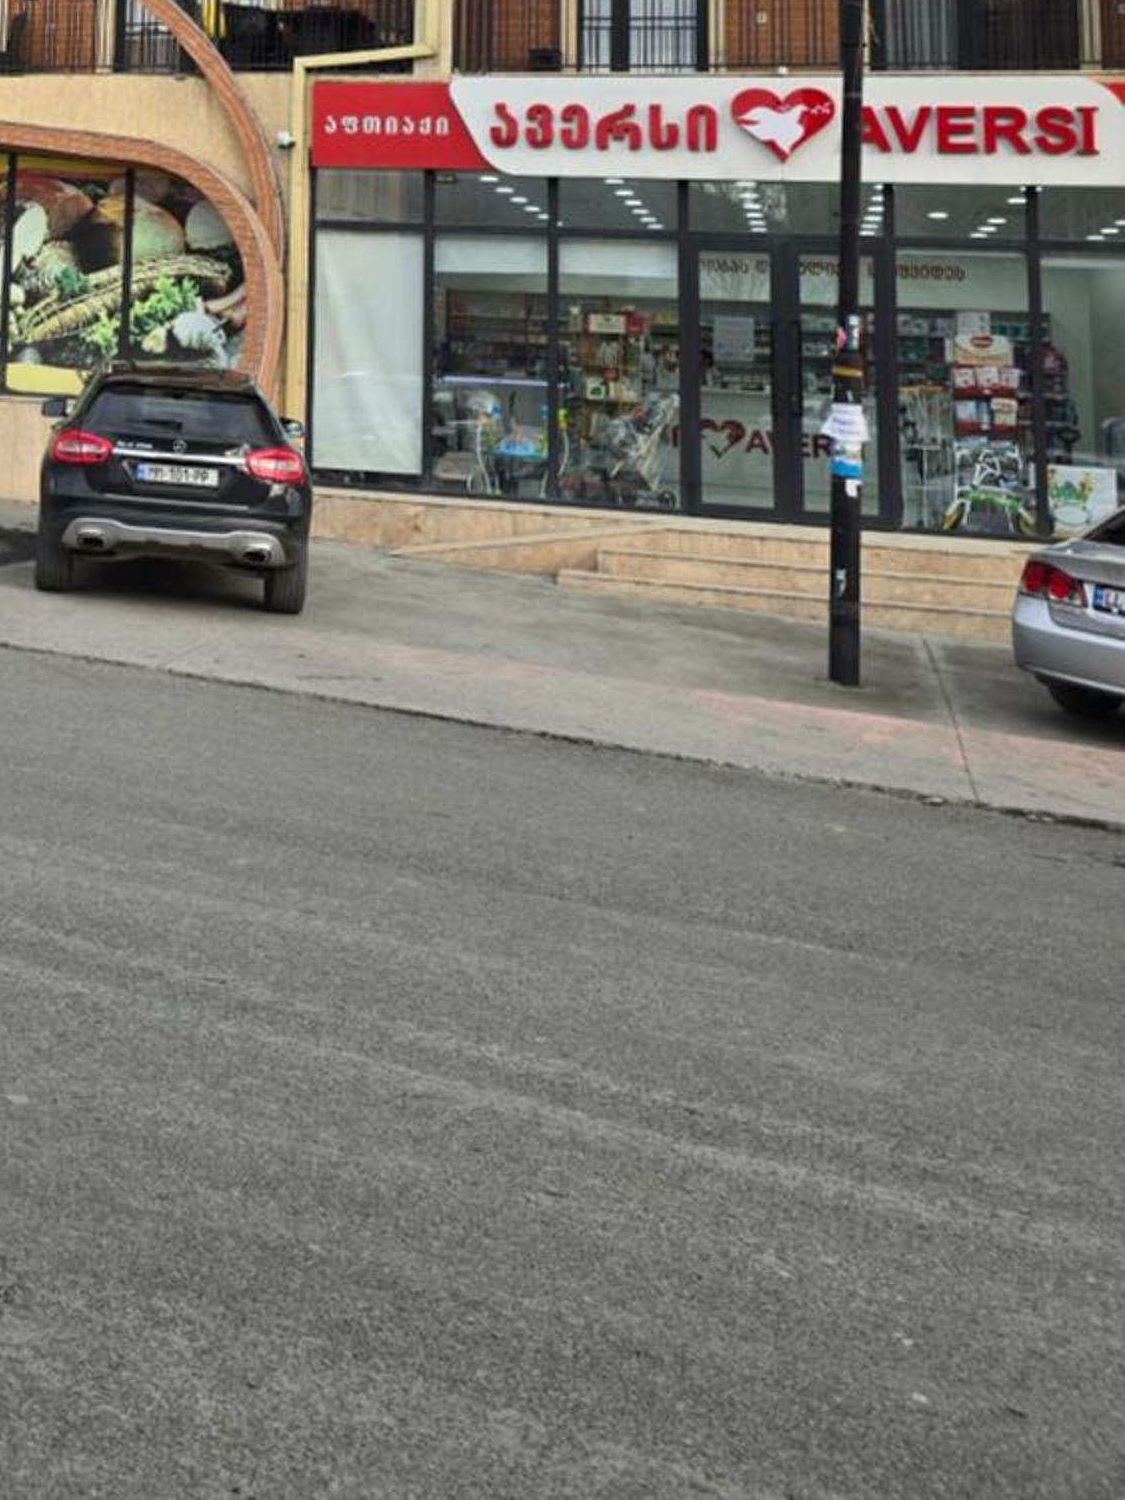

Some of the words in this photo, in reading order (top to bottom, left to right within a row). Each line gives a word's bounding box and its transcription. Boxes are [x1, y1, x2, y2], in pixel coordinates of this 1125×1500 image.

[323, 113, 451, 136] აფთიაქი
[489, 102, 719, 153] ავერსი
[860, 106, 1100, 157] AVERSI
